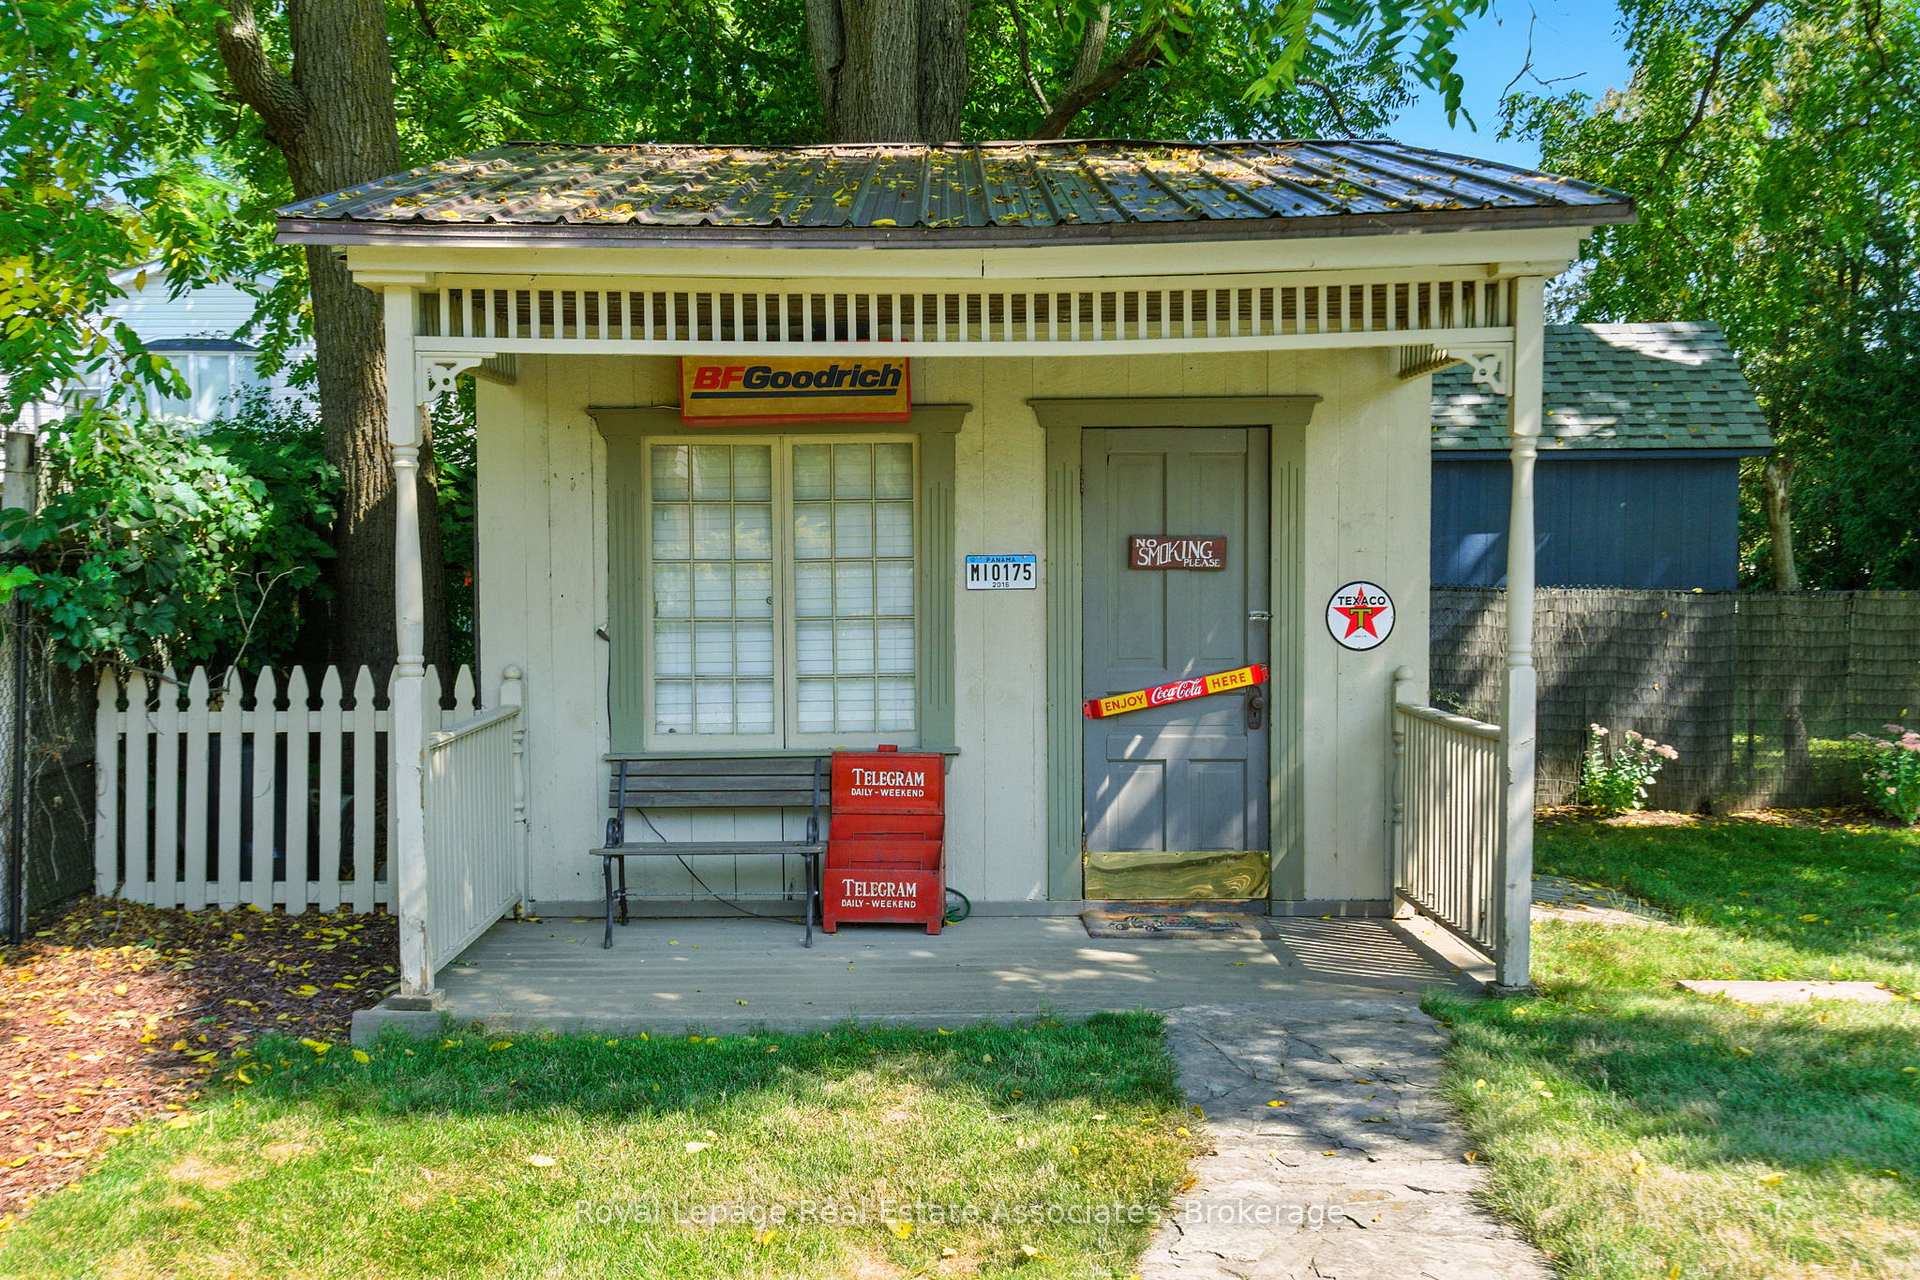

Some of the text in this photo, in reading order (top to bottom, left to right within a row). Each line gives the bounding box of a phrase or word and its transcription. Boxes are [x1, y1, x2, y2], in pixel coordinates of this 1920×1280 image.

[692, 363, 902, 390] BFGoodrich
[1135, 539, 1158, 548] NO
[1137, 540, 1213, 566] SMOKING
[1183, 558, 1221, 567] PLEASE
[1337, 596, 1386, 606] TEXACO
[1104, 693, 1145, 712] ENJOY
[1211, 672, 1247, 689] HERE
[851, 768, 925, 787] TELEGRAM
[841, 878, 917, 898] TELEGRAM
